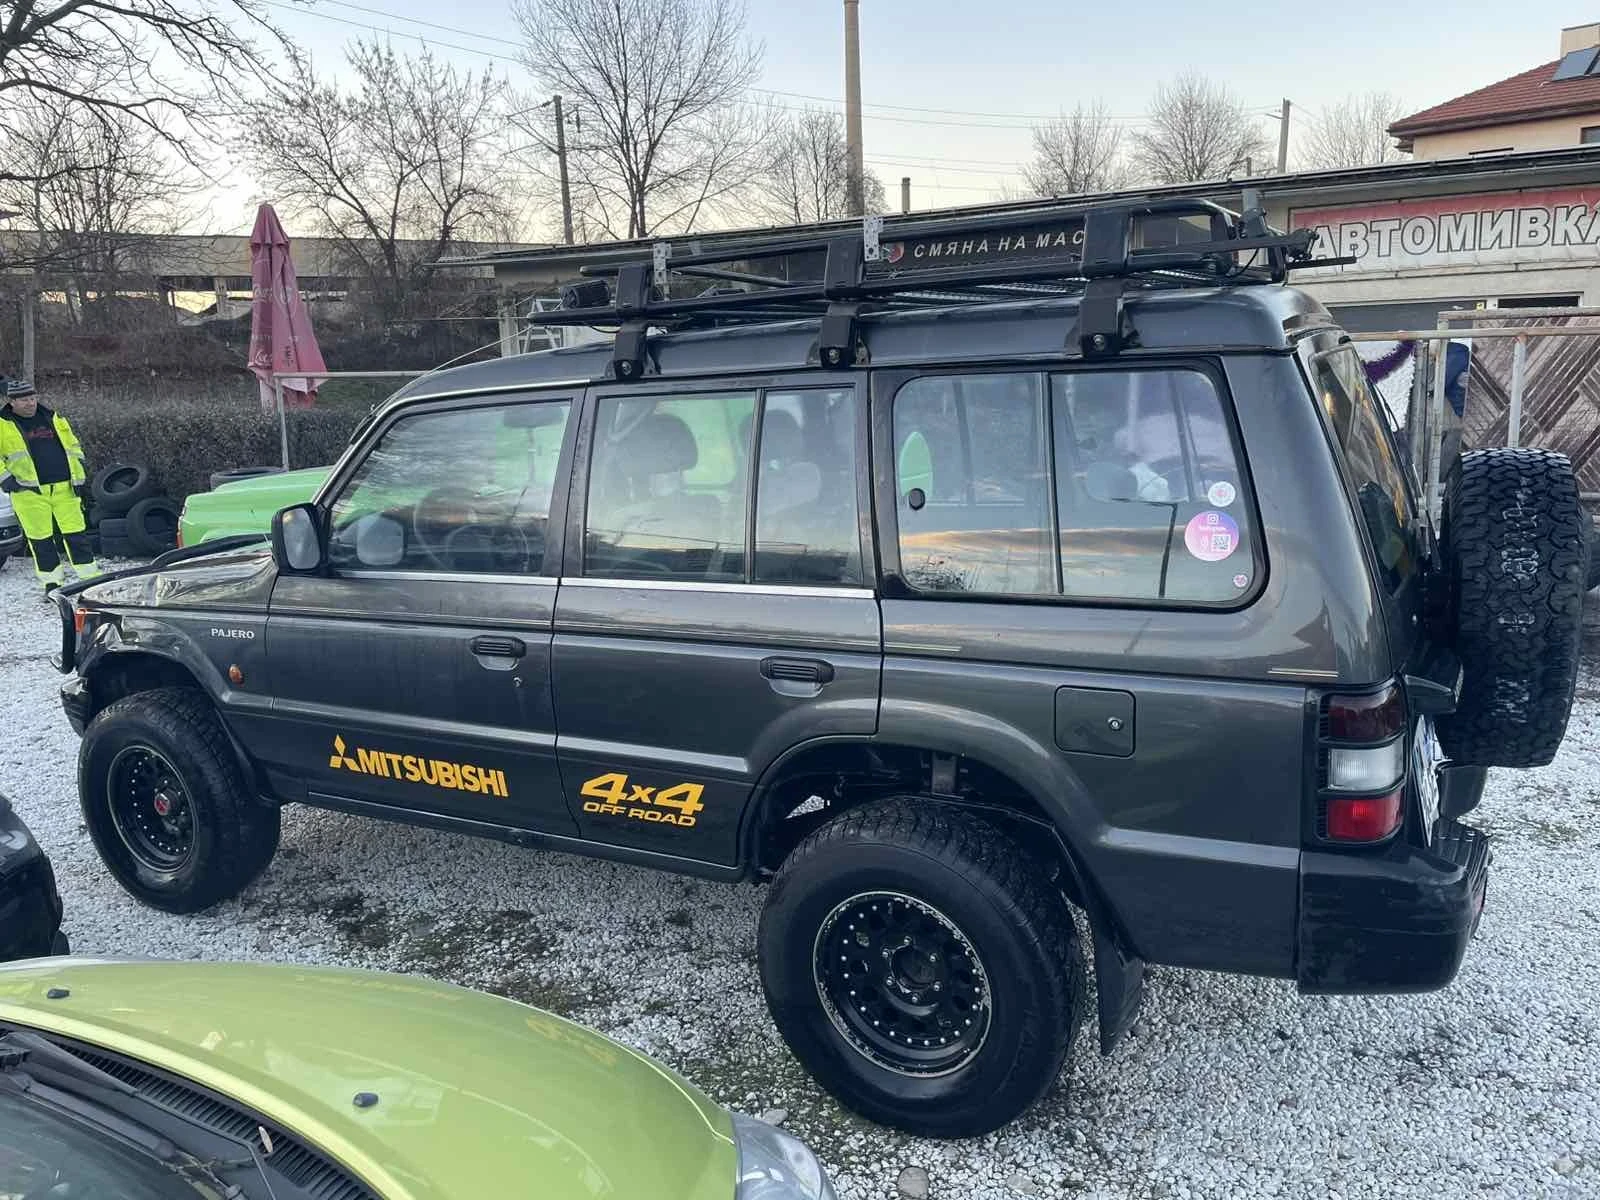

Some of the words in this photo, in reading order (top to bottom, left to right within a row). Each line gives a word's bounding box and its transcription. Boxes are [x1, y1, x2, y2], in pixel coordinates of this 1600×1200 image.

[914, 239, 989, 258] СМЯНА
[998, 236, 1026, 251] НА
[211, 628, 255, 639] PAJERO
[357, 748, 509, 797] MITSUBISHI
[580, 772, 704, 816] 4x4
[583, 801, 627, 815] OFF
[628, 808, 696, 826] ROAD
